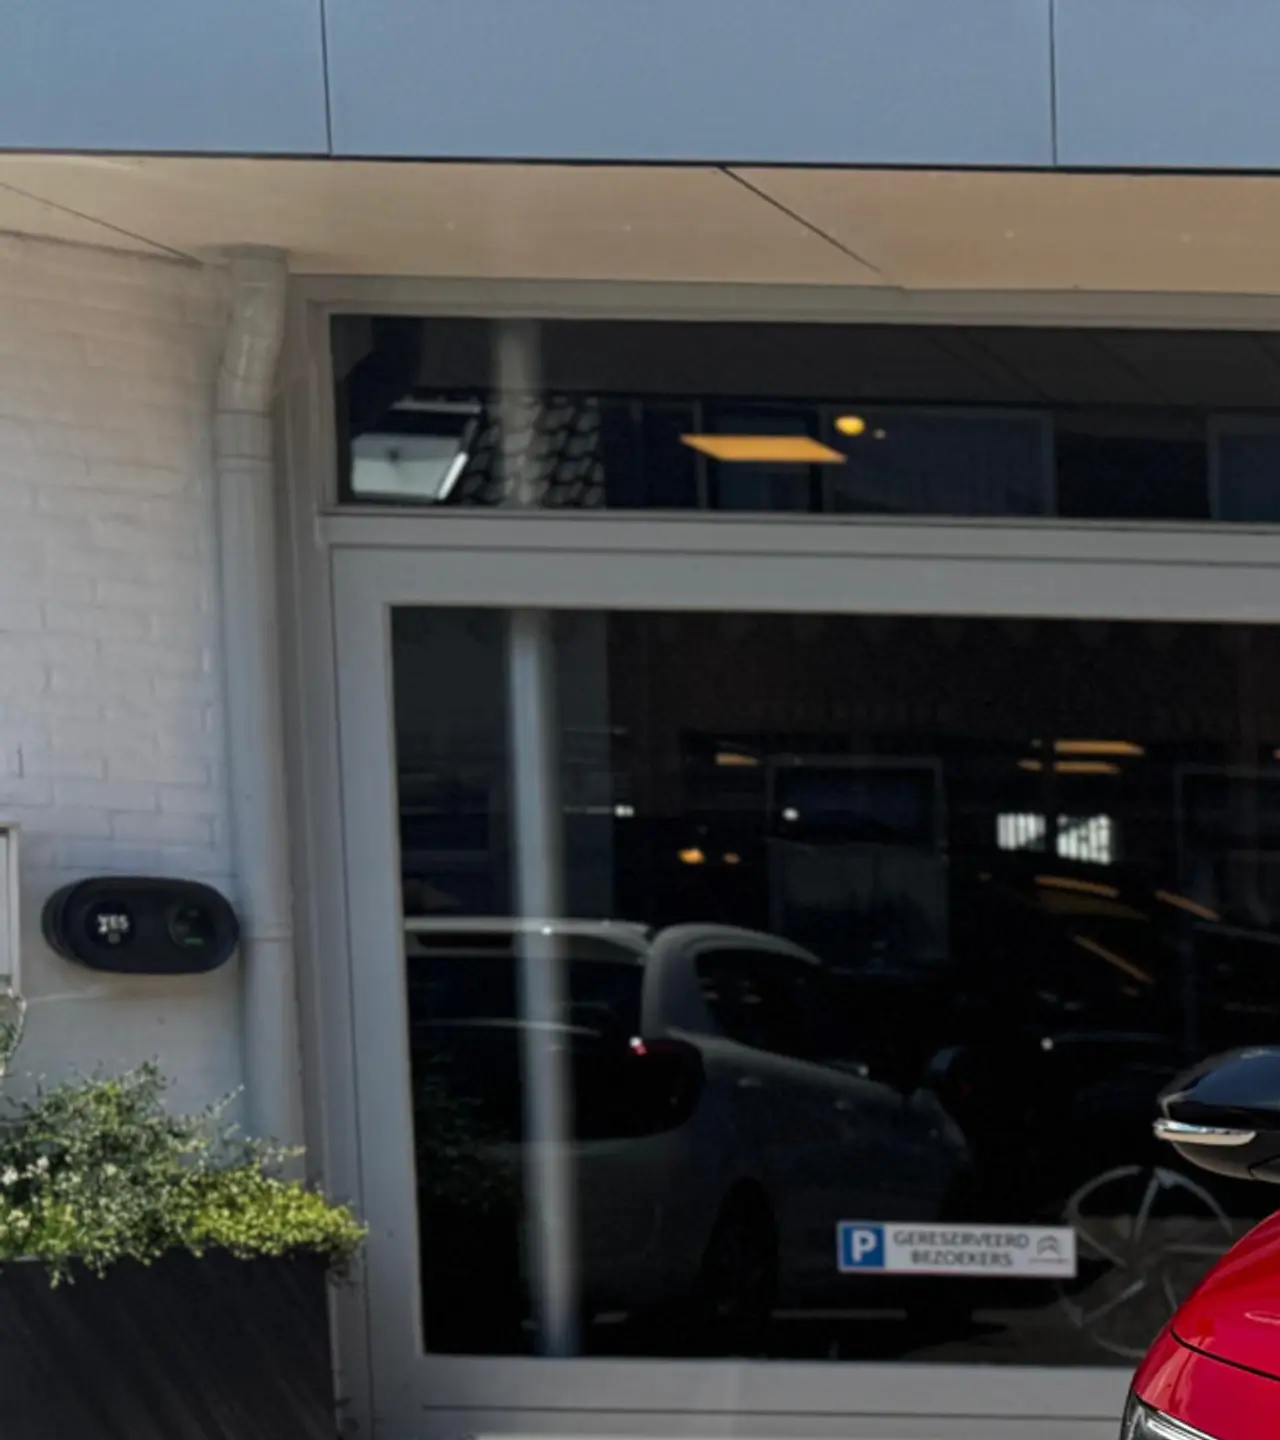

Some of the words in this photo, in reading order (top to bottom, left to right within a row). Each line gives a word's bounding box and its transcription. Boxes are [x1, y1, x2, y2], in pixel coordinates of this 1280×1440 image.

[852, 1230, 877, 1262] P
[893, 1230, 1030, 1249] GERESERVEERD
[911, 1250, 1013, 1266] BEZOEKERS
